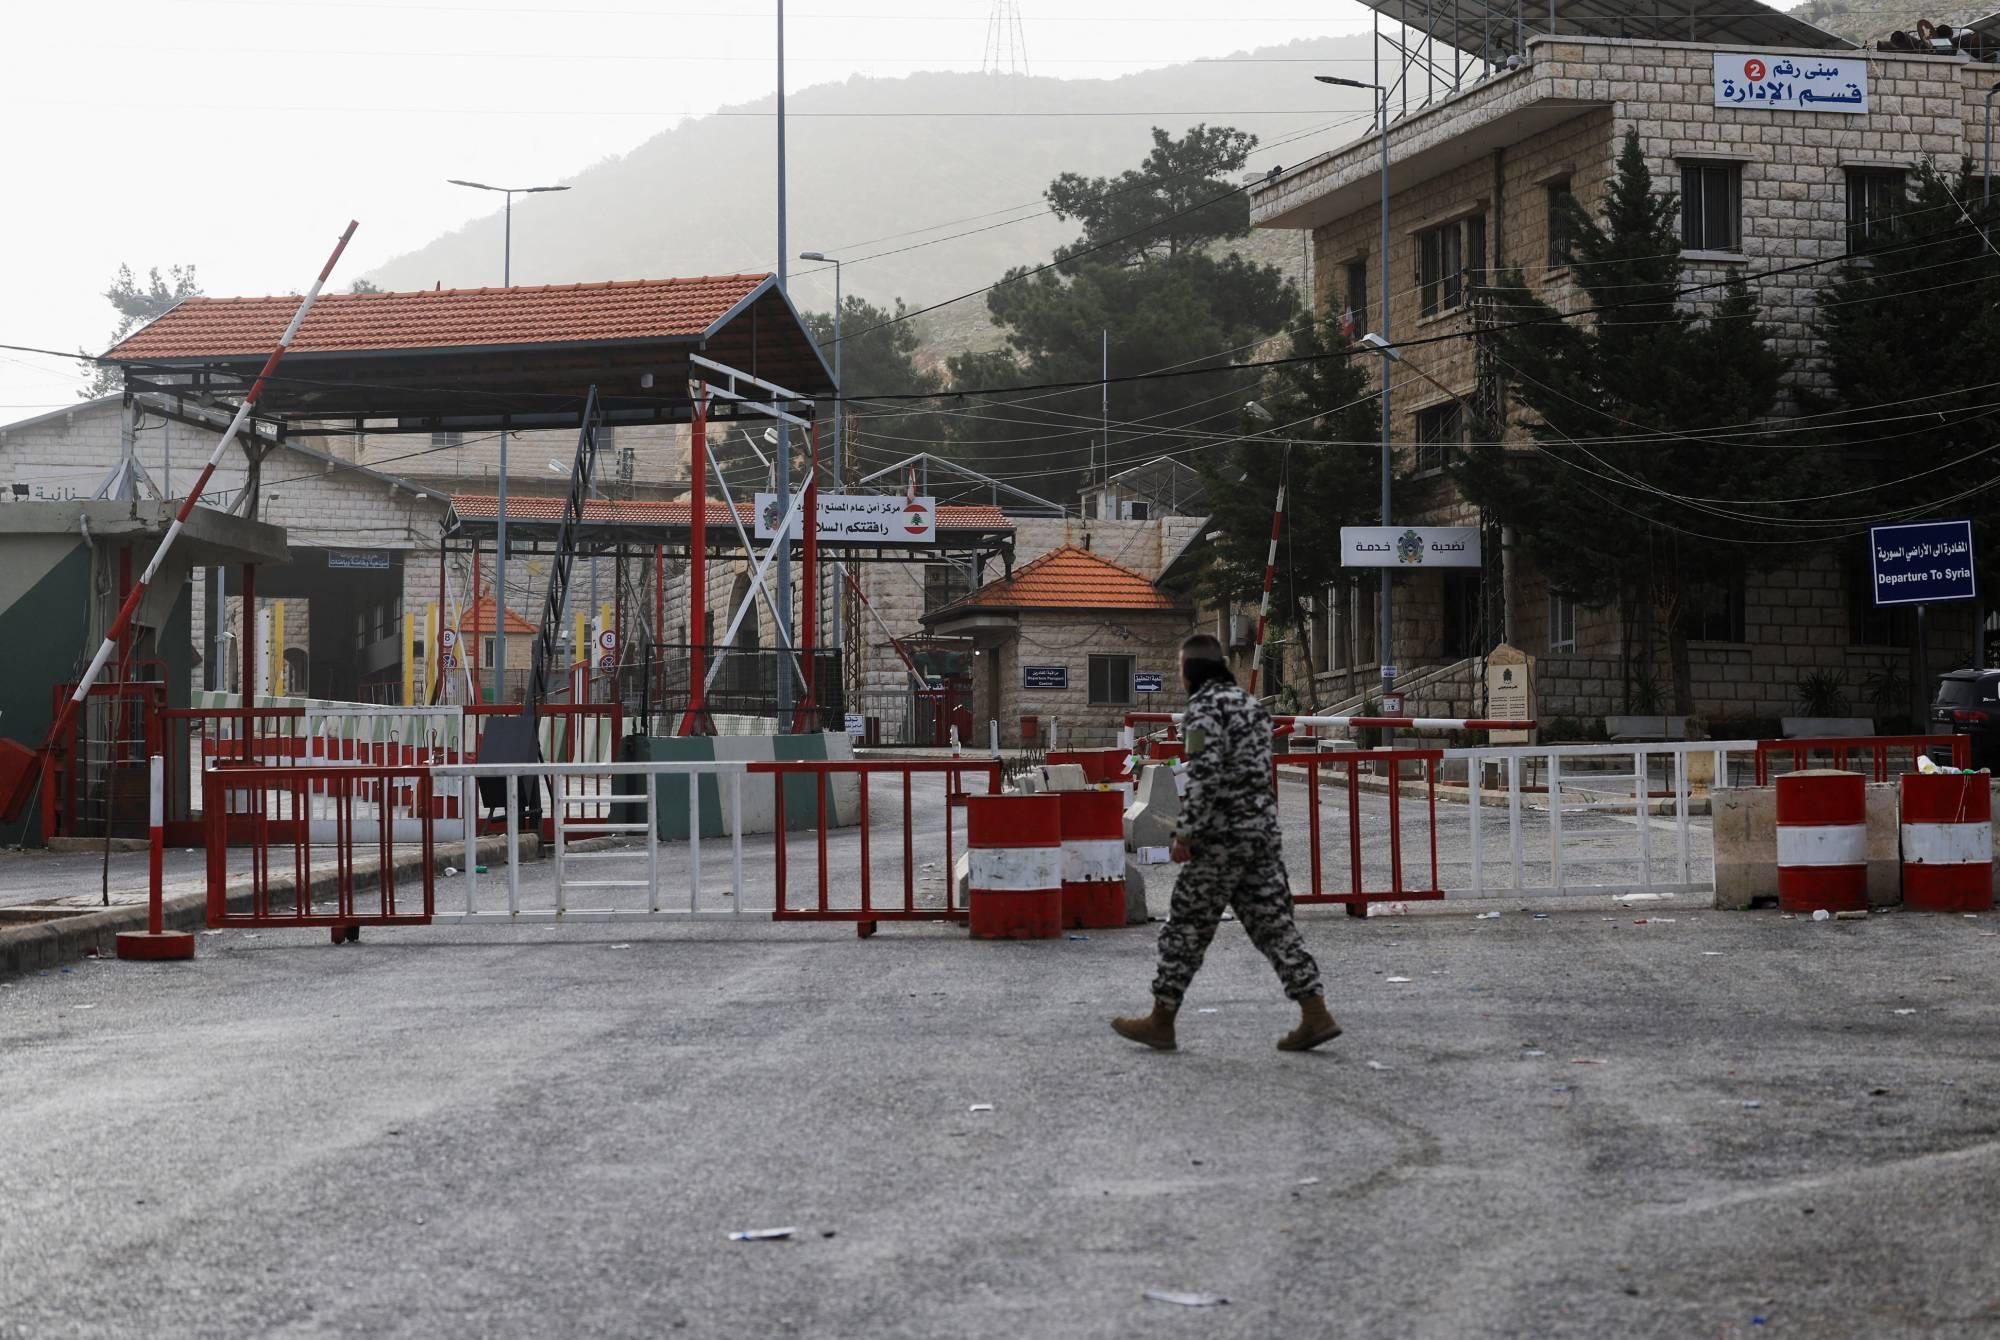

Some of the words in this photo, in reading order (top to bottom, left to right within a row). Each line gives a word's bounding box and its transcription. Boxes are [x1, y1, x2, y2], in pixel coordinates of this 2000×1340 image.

[1750, 63, 1761, 77] 2
[1773, 59, 1800, 78] رقم
[1804, 62, 1838, 81] مبنى
[1722, 79, 1792, 105] الإدارة
[1798, 83, 1863, 107] قسم
[824, 502, 848, 514] المصنع
[850, 503, 865, 513] عام
[881, 503, 900, 514] مركز
[801, 520, 843, 533] السلا
[845, 521, 889, 535] رافقتكم
[1355, 541, 1391, 552] خدمة
[1431, 541, 1465, 554] تضحية
[1944, 541, 1968, 556] المغادرة
[1877, 546, 1905, 562] السورية
[1878, 571, 1928, 586] Departure
[1930, 569, 1943, 580] To
[1945, 567, 1971, 581] Syria
